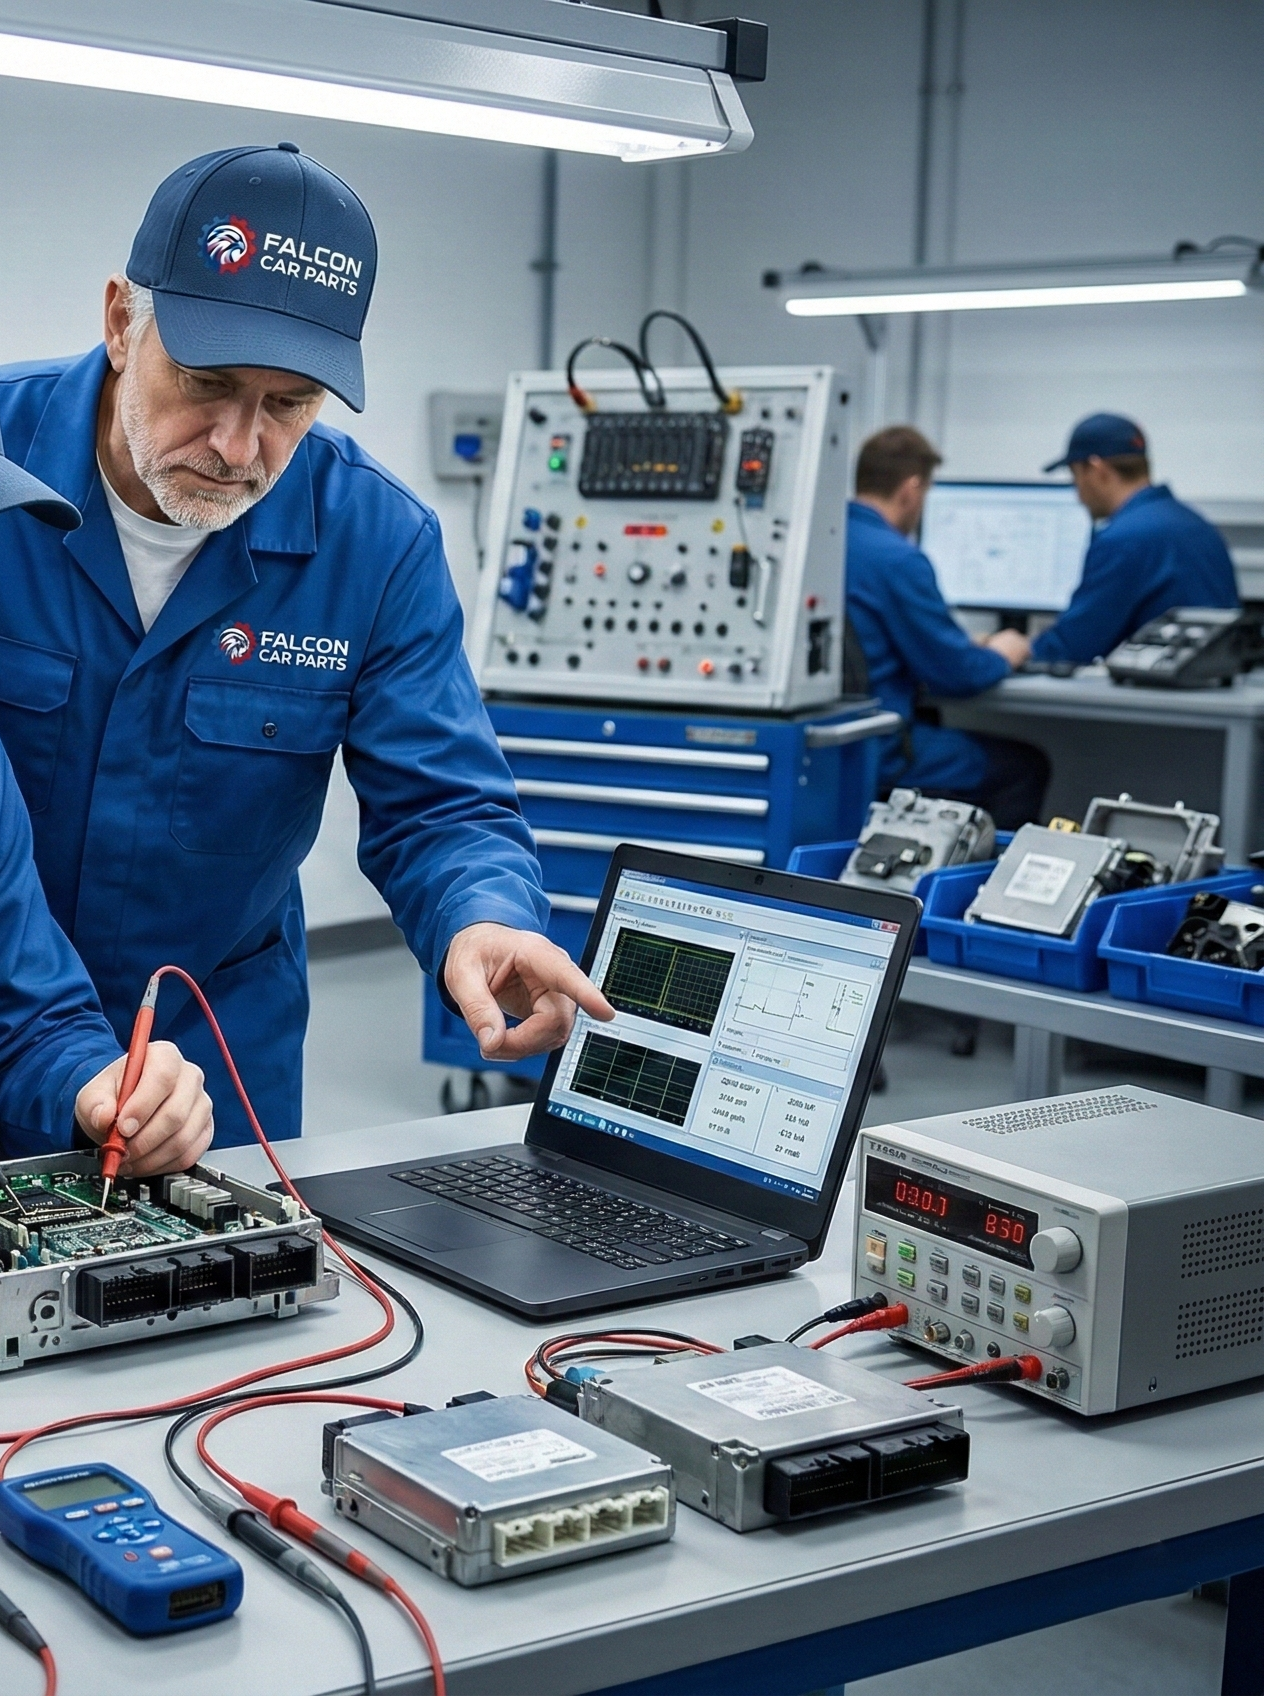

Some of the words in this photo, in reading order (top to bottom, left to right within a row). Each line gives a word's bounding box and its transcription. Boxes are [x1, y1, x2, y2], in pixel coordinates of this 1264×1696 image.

[263, 232, 363, 279] FALCON
[259, 255, 300, 279] CAR
[303, 266, 359, 296] PARTS
[258, 649, 292, 665] CAR
[295, 654, 348, 671] PARTS
[260, 631, 350, 657] FALCON
